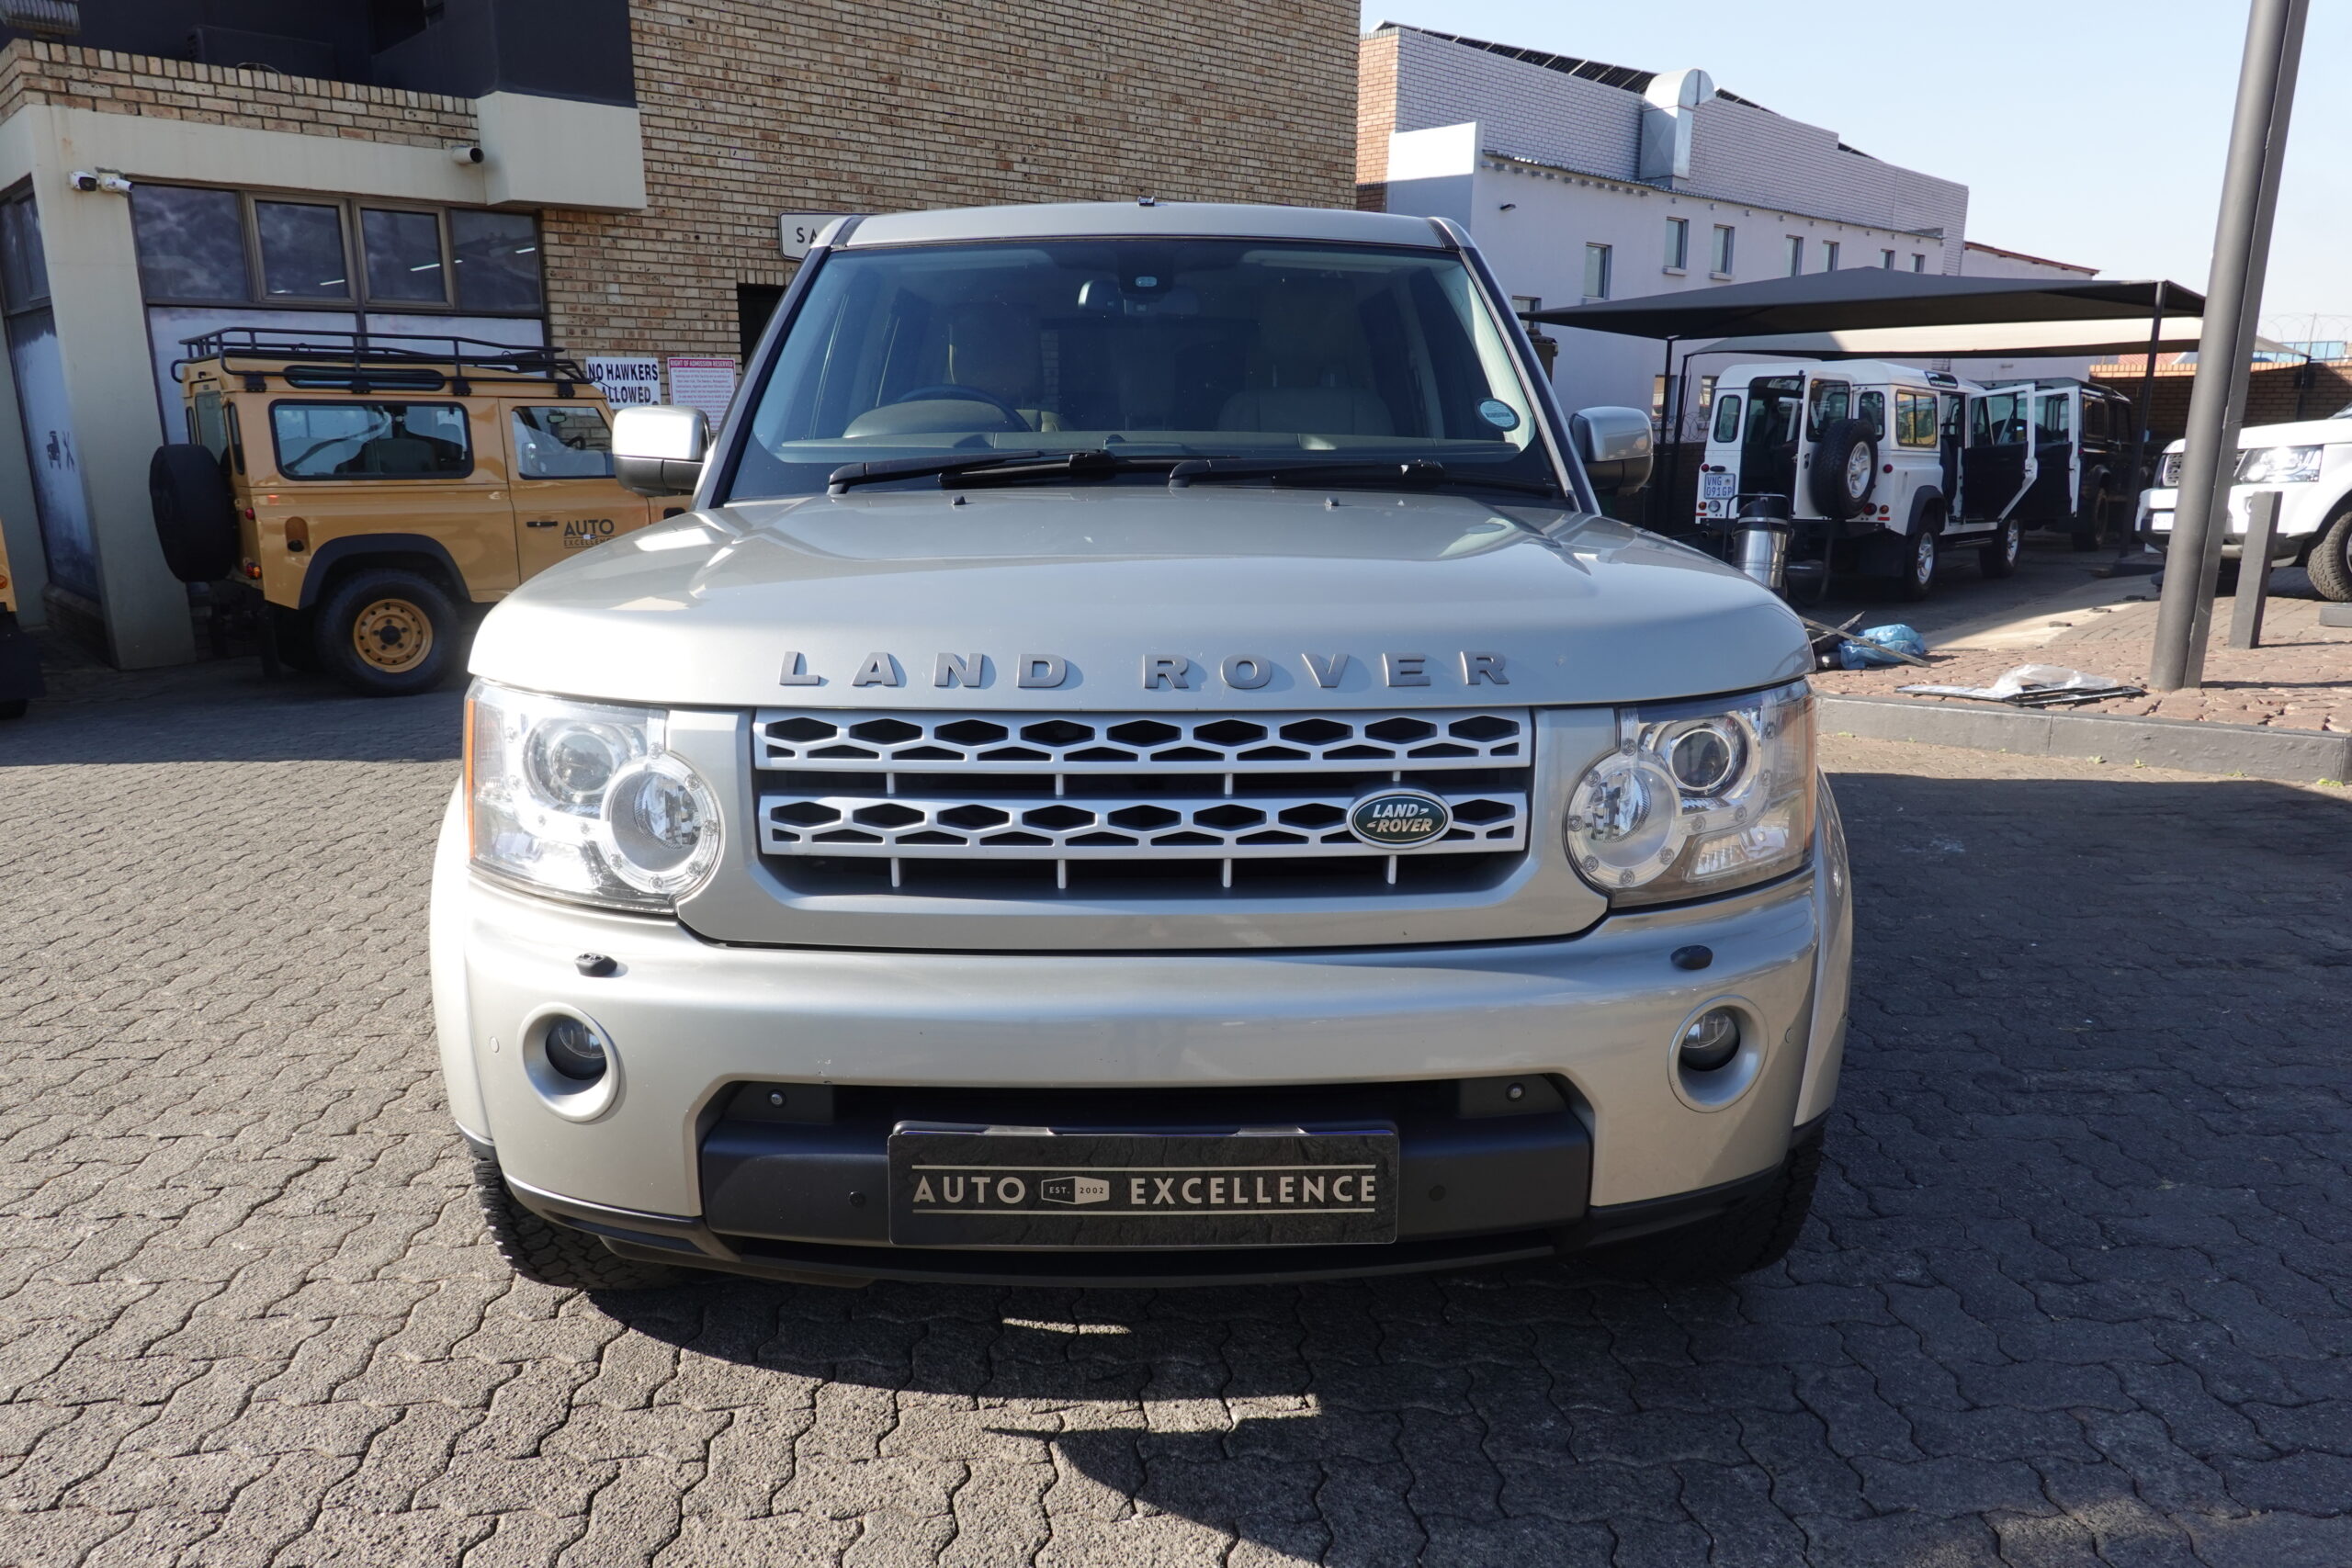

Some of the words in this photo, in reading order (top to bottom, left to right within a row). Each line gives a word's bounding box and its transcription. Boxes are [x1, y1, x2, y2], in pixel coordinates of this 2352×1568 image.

[588, 363, 604, 380] NO
[606, 364, 659, 380] HAWKERS
[1707, 476, 1722, 486] VNG
[564, 519, 615, 536] AUTO
[778, 651, 1066, 688] LAND
[1143, 651, 1510, 689] ROVER
[1373, 804, 1419, 818] LAND
[1376, 818, 1433, 832] ROVER
[912, 1175, 1026, 1204] AUTO
[1049, 1186, 1070, 1194] EST.
[1130, 1174, 1377, 1205] EXCELLENCE
